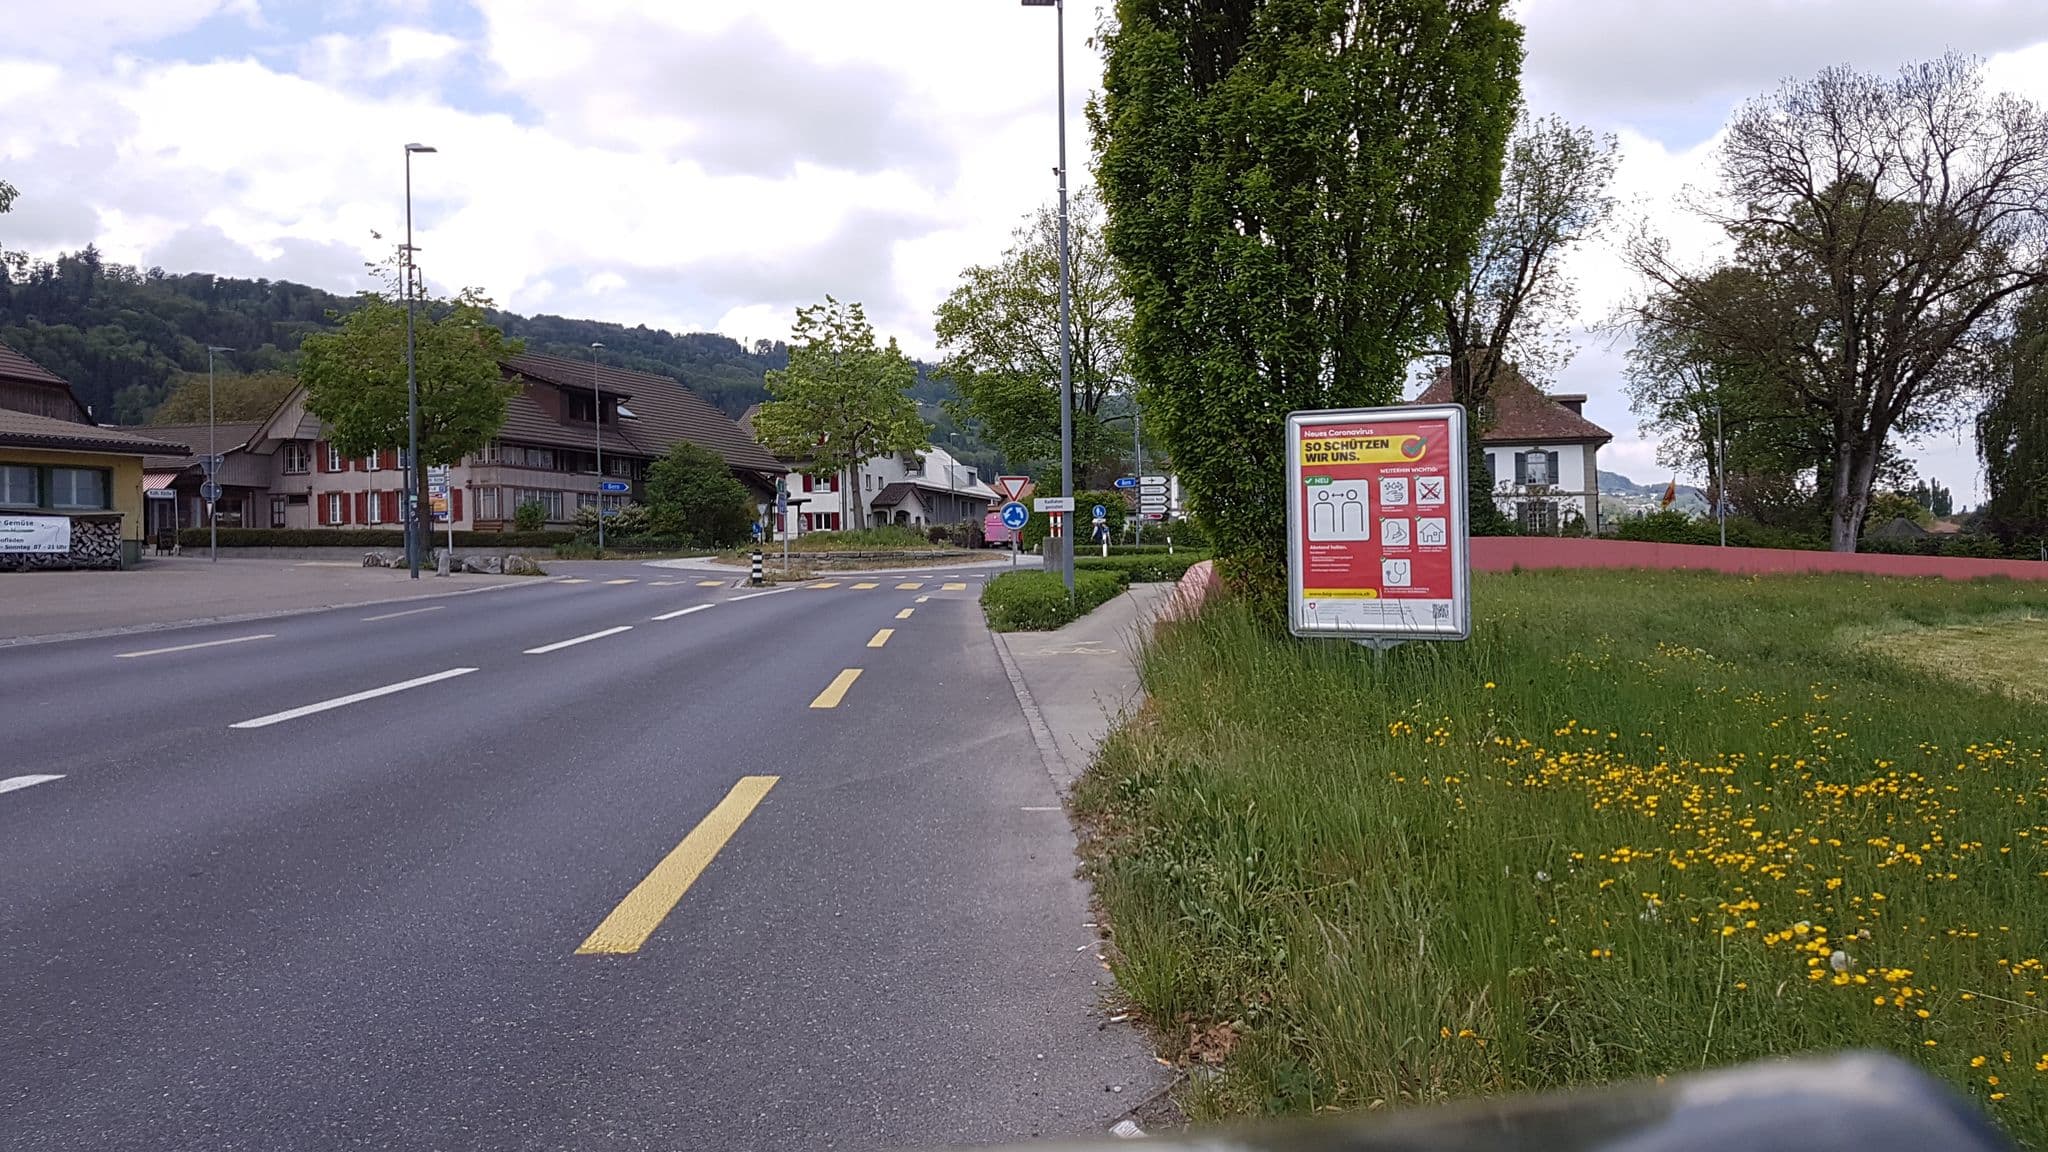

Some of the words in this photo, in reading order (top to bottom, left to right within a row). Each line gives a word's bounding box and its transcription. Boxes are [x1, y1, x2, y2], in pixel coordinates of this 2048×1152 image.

[1304, 430, 1327, 438] Neues
[1328, 427, 1374, 437] Coronavirus
[1305, 442, 1322, 452] SO
[1323, 439, 1389, 451] SCHÜTZEN
[1305, 453, 1329, 463] WIR
[1331, 451, 1360, 462] UNS.
